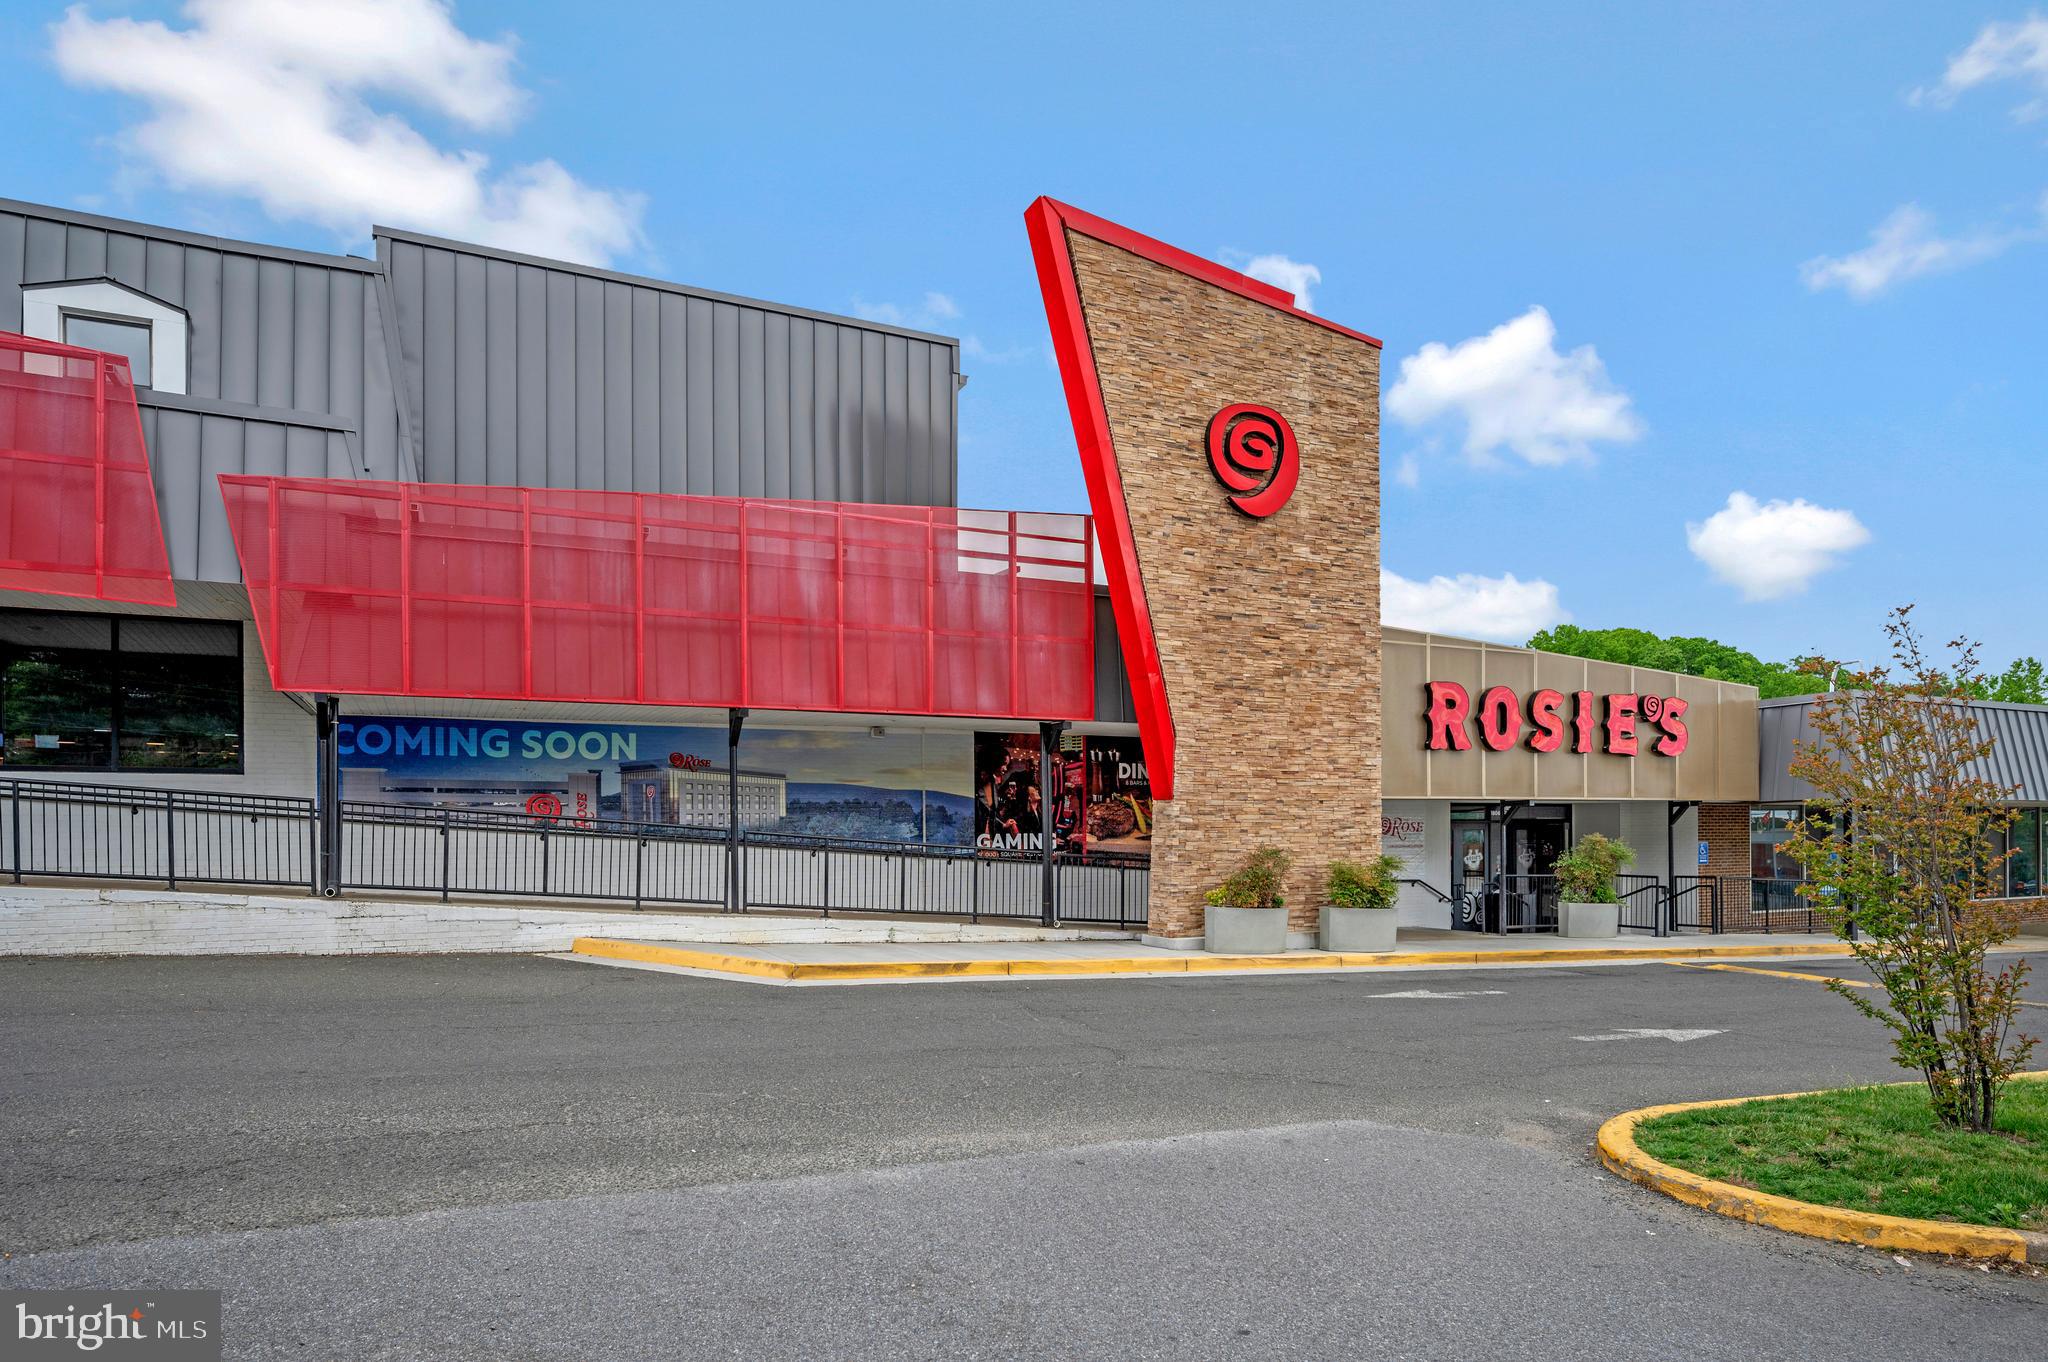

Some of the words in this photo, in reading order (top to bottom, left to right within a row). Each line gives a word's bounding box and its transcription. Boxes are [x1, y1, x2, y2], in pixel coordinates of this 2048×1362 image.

[1424, 681, 1689, 757] ROSIE'S
[338, 723, 510, 758] COMING
[522, 729, 637, 761] SOON
[1390, 817, 1424, 841] ROSE
